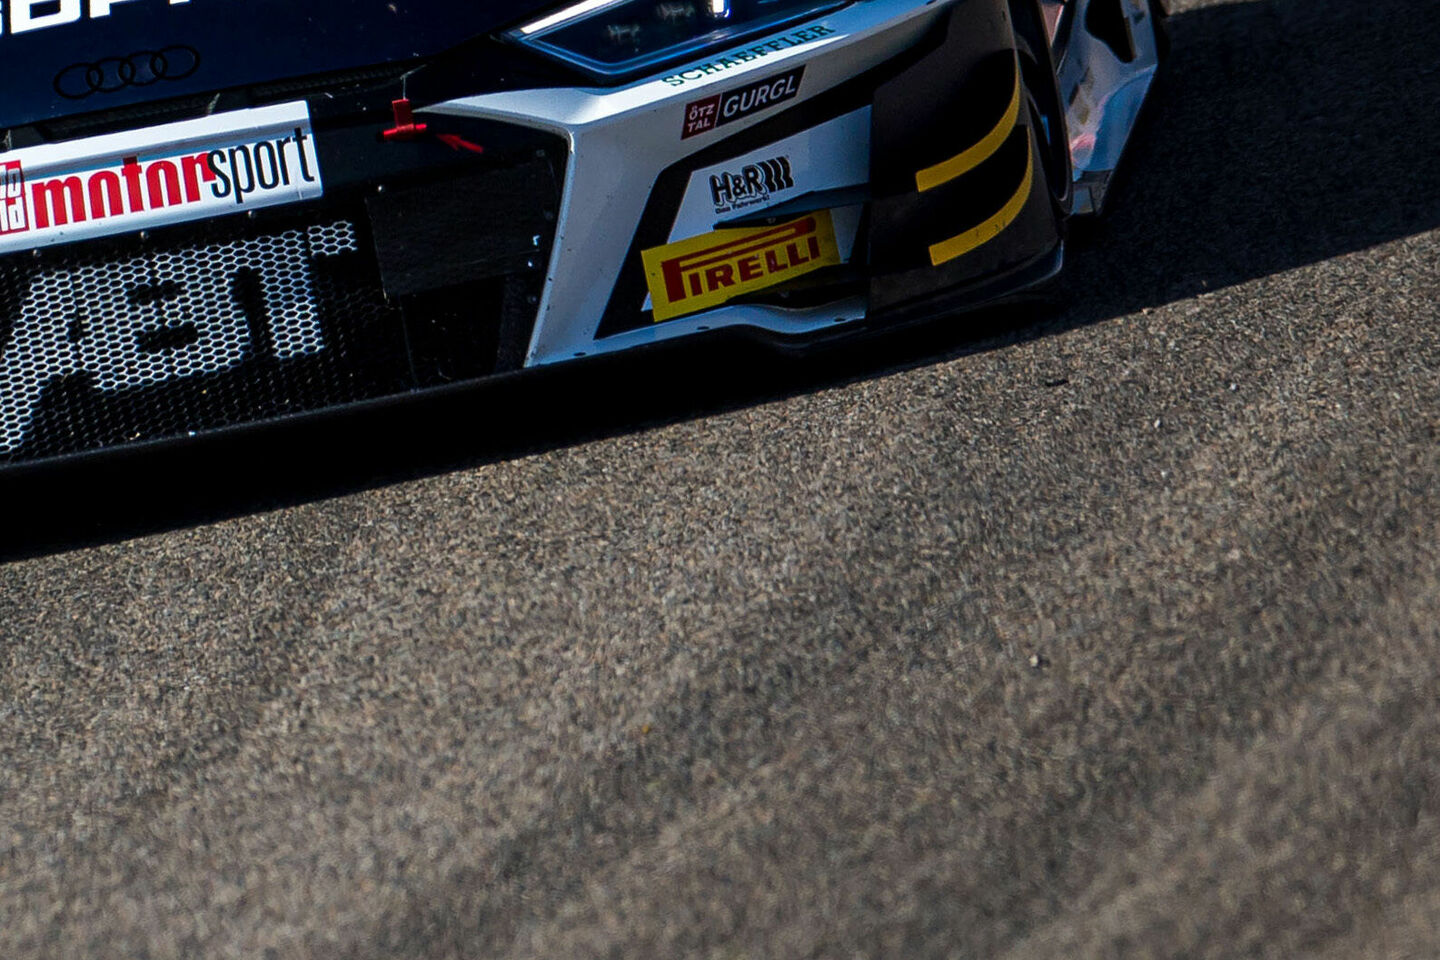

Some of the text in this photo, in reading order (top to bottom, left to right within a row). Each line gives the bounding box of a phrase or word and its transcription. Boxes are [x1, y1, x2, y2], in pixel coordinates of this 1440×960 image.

[661, 24, 837, 87] SCHAEFFLER
[723, 75, 796, 118] GURGL
[709, 165, 769, 205] H&R
[661, 217, 821, 303] PIRELLI
